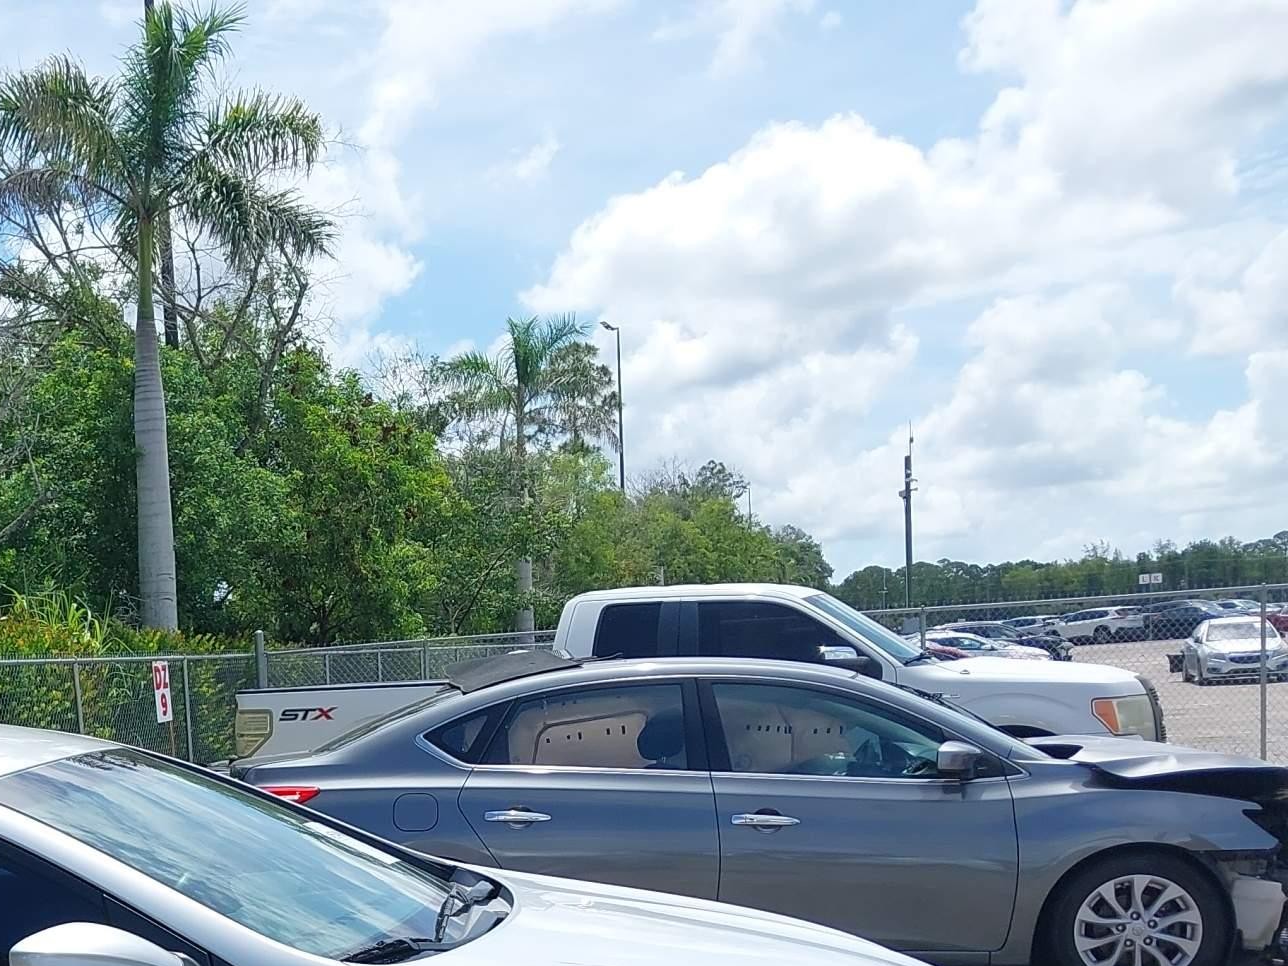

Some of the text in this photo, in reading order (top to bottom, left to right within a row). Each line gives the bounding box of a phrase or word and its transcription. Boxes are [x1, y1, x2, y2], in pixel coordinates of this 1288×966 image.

[154, 665, 168, 690] DZ
[160, 693, 168, 717] 9
[279, 706, 338, 722] STX
